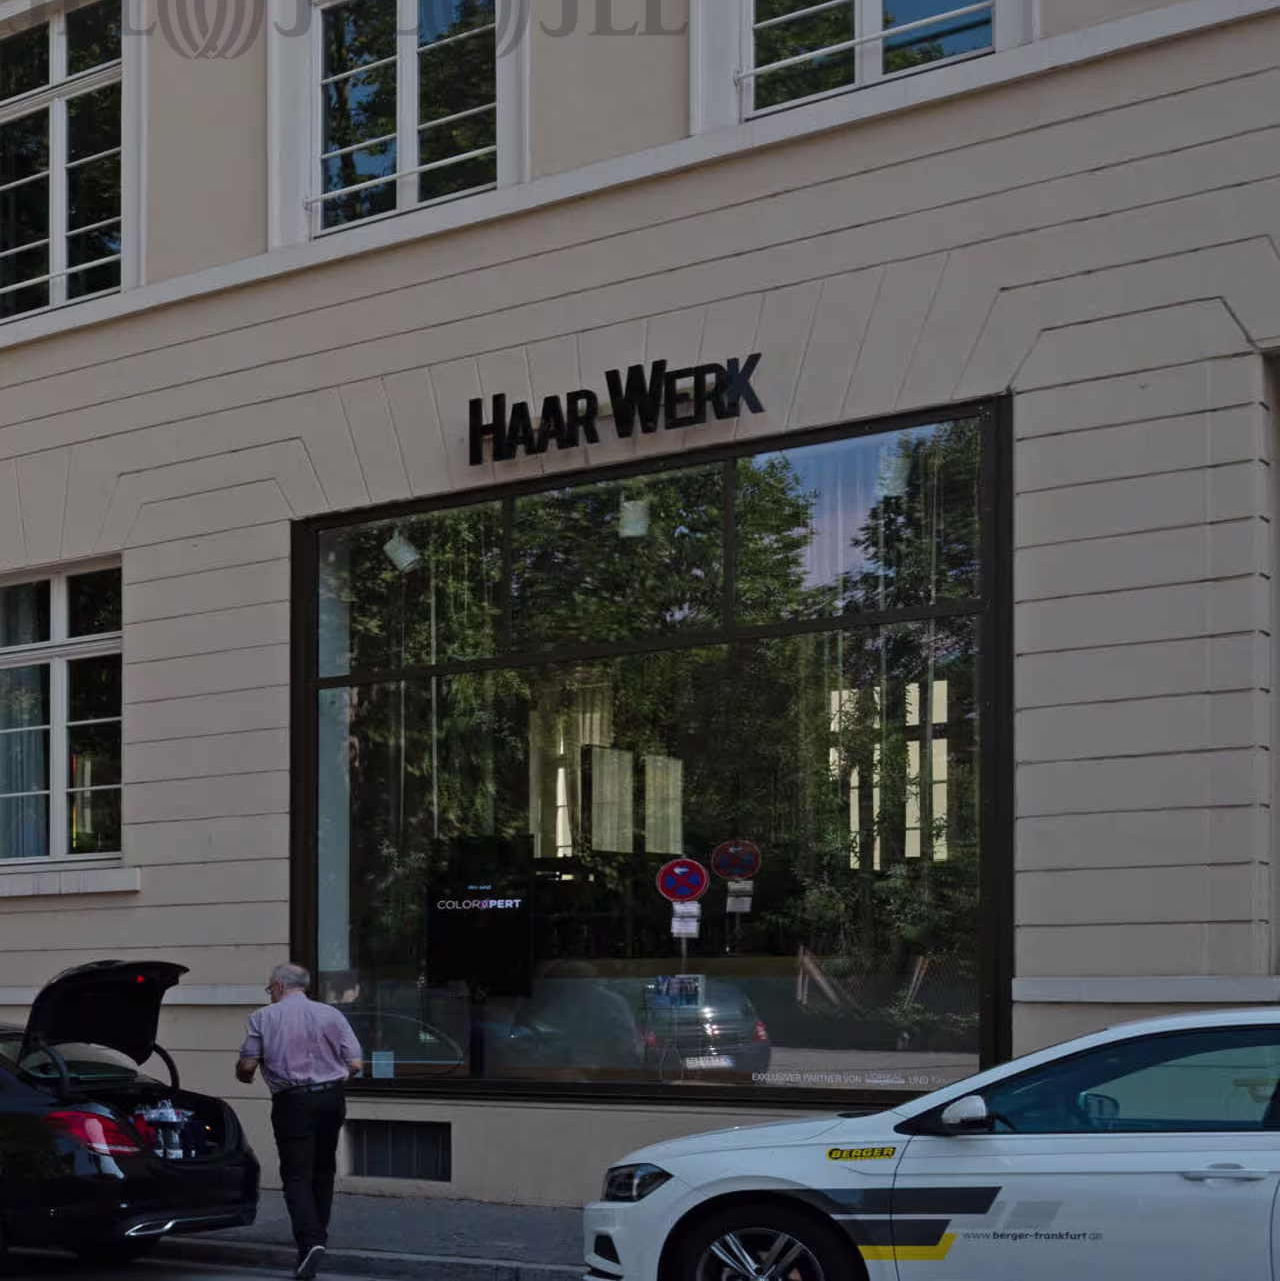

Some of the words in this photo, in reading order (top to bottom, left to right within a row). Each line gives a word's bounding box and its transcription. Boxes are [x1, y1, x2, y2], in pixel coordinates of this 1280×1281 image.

[469, 389, 600, 465] HAAR
[605, 353, 765, 439] WERK
[802, 1073, 842, 1083] PARTNER
[843, 1074, 862, 1083] VON
[830, 1147, 895, 1159] BERGER
